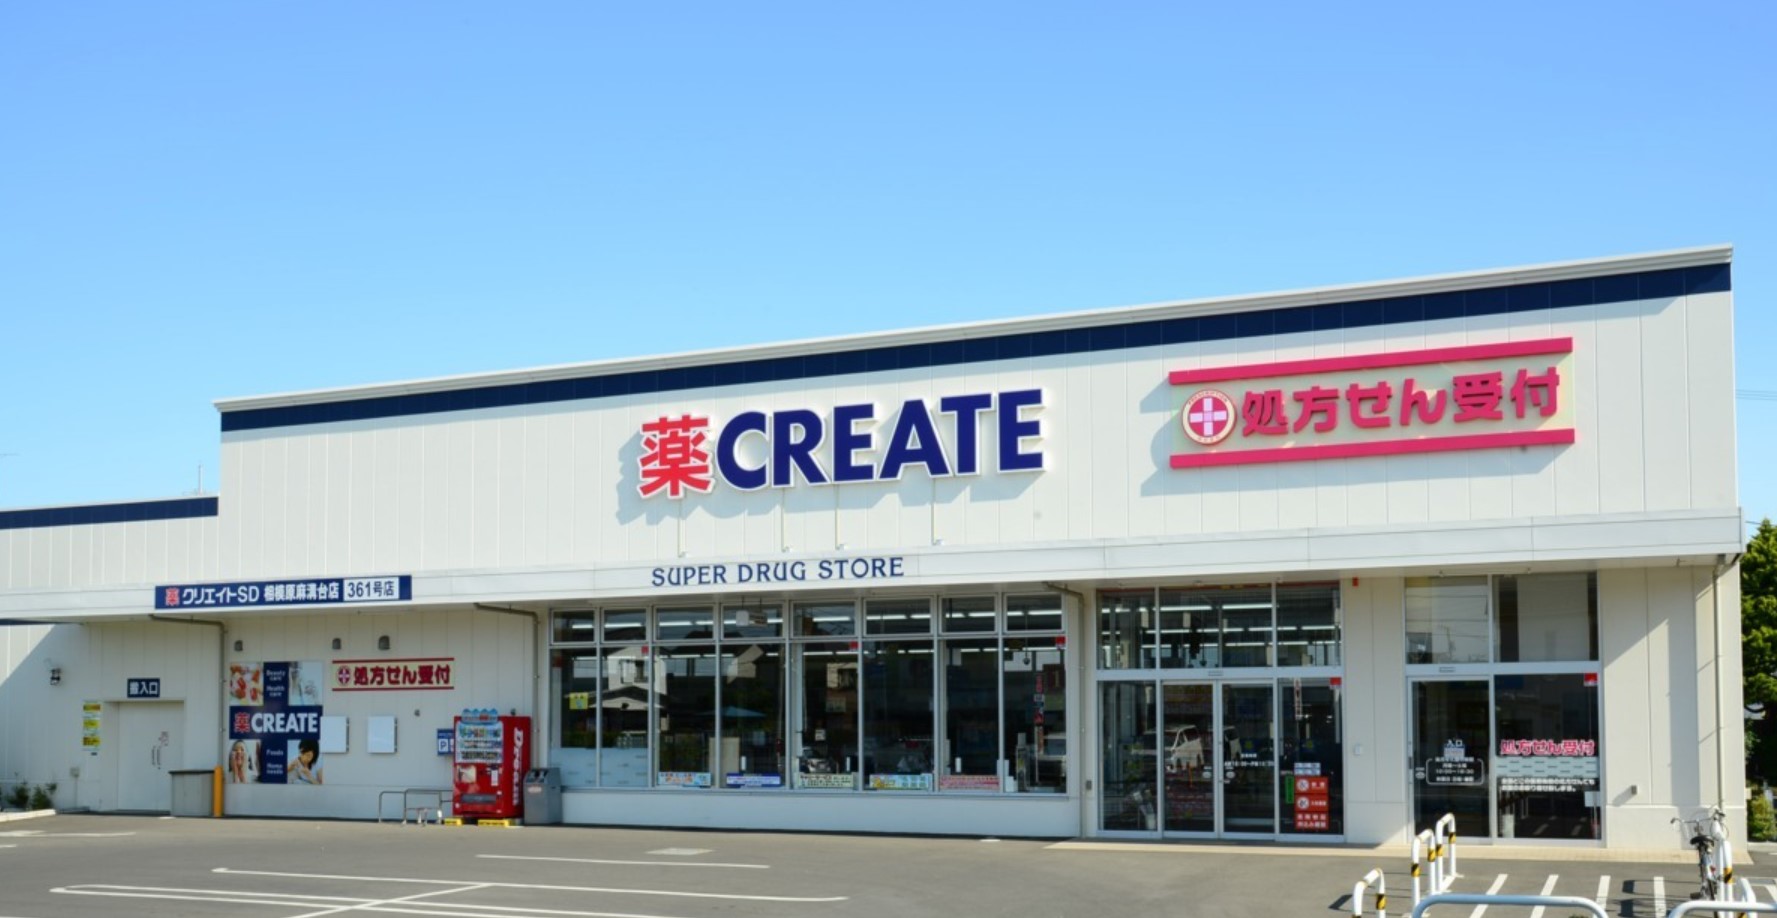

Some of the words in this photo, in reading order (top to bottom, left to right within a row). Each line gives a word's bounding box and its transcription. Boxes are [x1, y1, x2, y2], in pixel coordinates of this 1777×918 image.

[1241, 366, 1561, 438] 処方せん受付
[651, 565, 728, 587] SUPER
[737, 561, 806, 583] DRUG
[817, 556, 905, 580] STORE
[346, 580, 395, 599] 361号店
[353, 664, 451, 686] 処方せん受付
[1499, 738, 1596, 756] 処方せん受付
